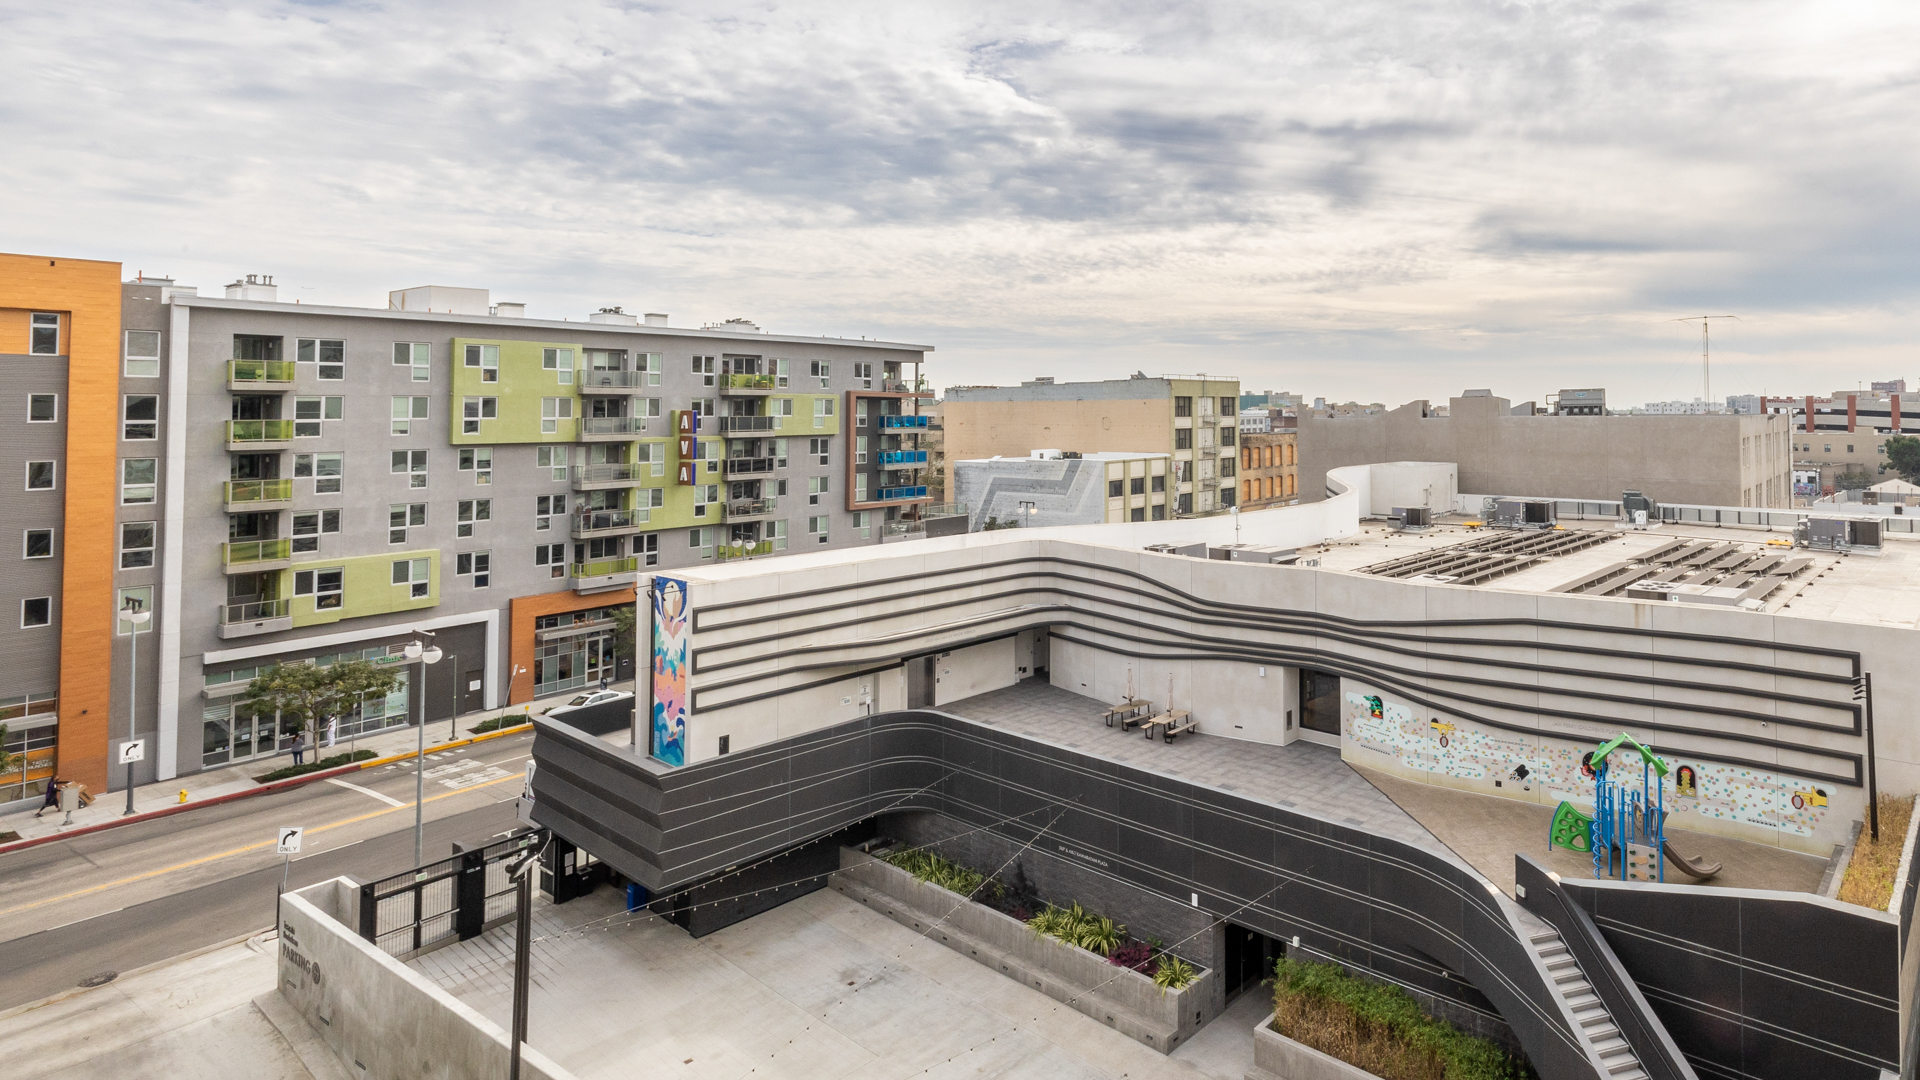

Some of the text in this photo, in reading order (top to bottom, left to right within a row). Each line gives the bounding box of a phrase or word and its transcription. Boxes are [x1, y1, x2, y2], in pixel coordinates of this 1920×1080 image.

[680, 414, 689, 482] AVA
[573, 616, 595, 629] 236
[376, 656, 402, 665] Clinic
[282, 942, 311, 975] PARKING
